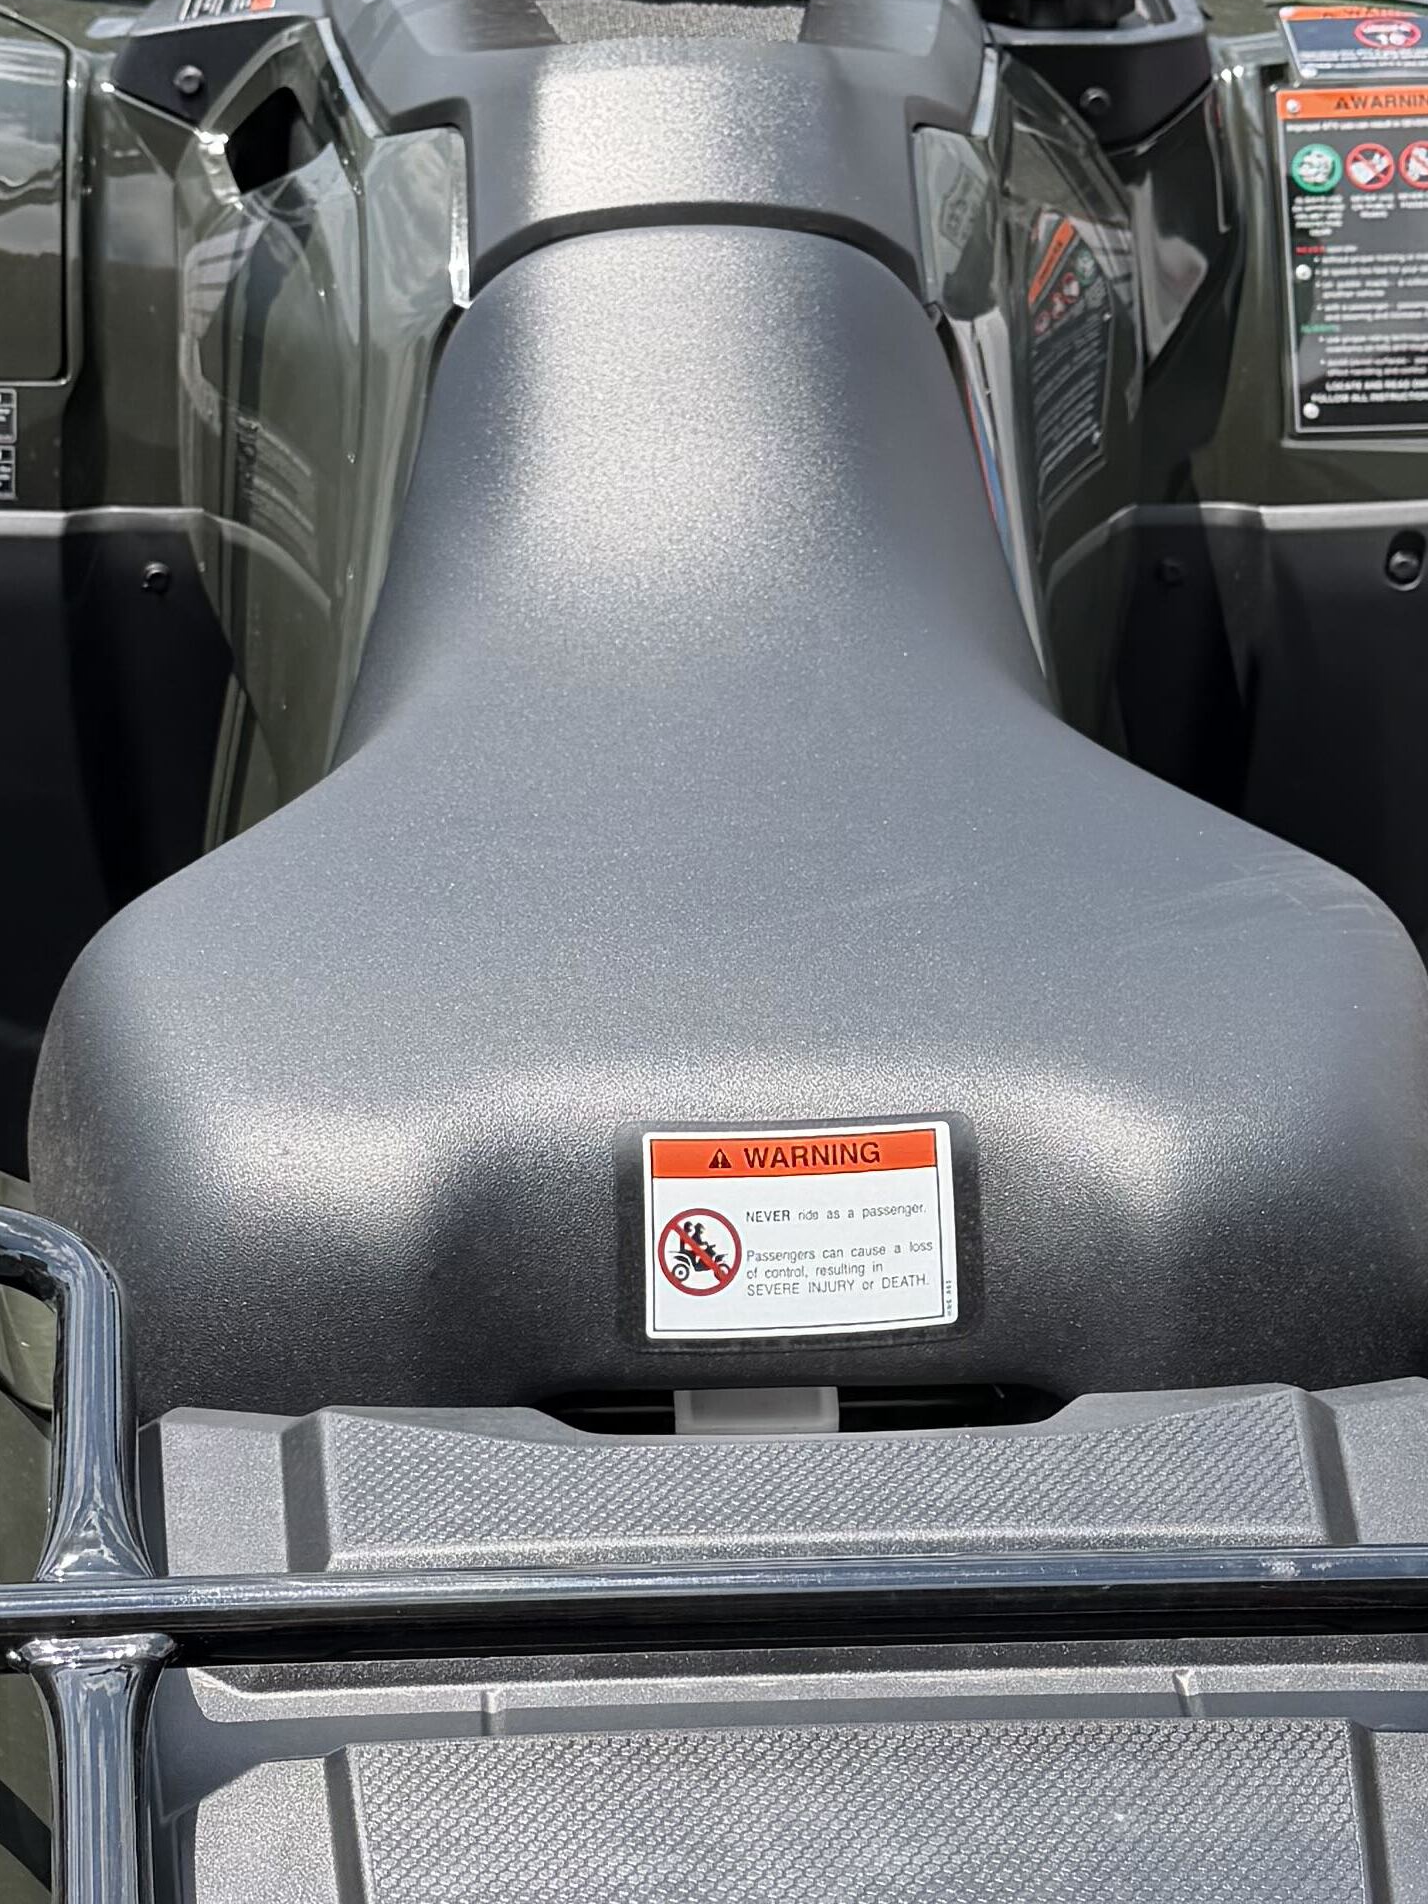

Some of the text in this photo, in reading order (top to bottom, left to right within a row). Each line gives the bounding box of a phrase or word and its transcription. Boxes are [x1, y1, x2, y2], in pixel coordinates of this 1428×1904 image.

[744, 1142, 881, 1170] WARNING
[746, 1203, 927, 1223] NEVER ride as a passenger.
[746, 1240, 933, 1263] Passengers can cause a loss
[746, 1261, 884, 1279] of control, resulting in
[747, 1275, 930, 1297] SEVERE INJURY or DEATH.
